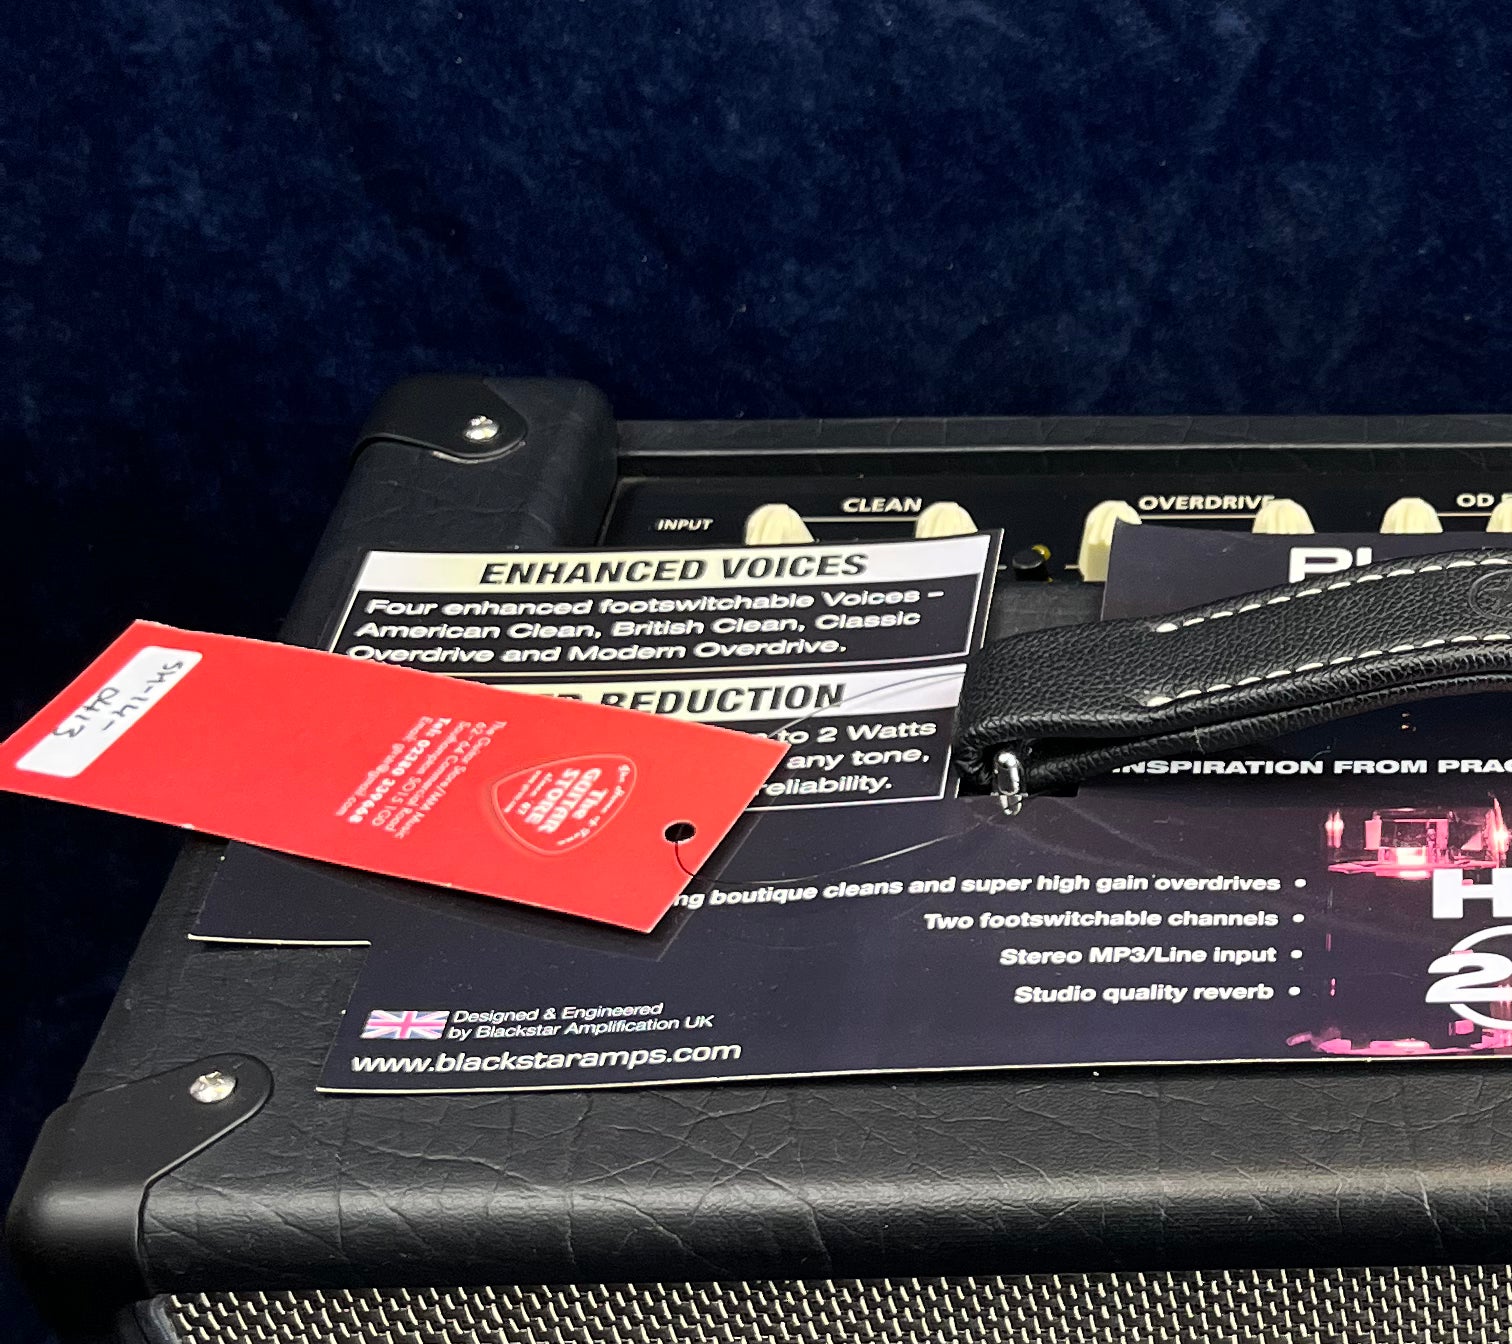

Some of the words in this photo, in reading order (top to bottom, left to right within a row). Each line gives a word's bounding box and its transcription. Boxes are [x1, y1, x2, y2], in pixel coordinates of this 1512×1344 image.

[842, 497, 922, 513] CLEAN
[1456, 493, 1495, 507] OD
[656, 518, 713, 531] INPUT
[480, 559, 706, 584] ENHANCED
[722, 554, 869, 579] VOICES
[365, 599, 438, 615] Four
[441, 599, 594, 616] enhanced
[599, 593, 815, 614] footswitchable
[821, 590, 921, 608] Voices
[354, 622, 500, 639] American
[506, 622, 602, 640] Clean,
[611, 619, 705, 637] British
[711, 615, 805, 635] Clean,
[815, 611, 921, 630] Classic
[346, 645, 494, 663] Overdrive
[502, 646, 561, 663] and
[567, 642, 687, 662] Modern
[693, 639, 847, 658] Overdrive.
[600, 683, 846, 716] REDUCTION
[776, 730, 809, 745] to
[816, 726, 838, 743] 2
[846, 721, 938, 742] Watts
[787, 754, 844, 771] any
[852, 748, 930, 766] tone,
[1112, 759, 1324, 775] NSPIRATION
[1334, 759, 1428, 775] FROM
[523, 767, 583, 826] STORE
[709, 886, 818, 905] boutique
[823, 880, 904, 899] cleans
[907, 877, 956, 894] and
[961, 877, 1033, 895] super
[1036, 874, 1090, 894] high
[1096, 874, 1149, 895] gain
[1154, 875, 1281, 892] overdrives
[924, 912, 975, 930] Two
[979, 910, 1162, 929] footswitchable
[1167, 910, 1280, 927] channels
[1000, 948, 1083, 966] Stereo
[1089, 946, 1208, 964] MP3/Line
[1213, 946, 1278, 966] input
[1014, 985, 1097, 1004] Studio
[1102, 983, 1188, 1004] quality
[1193, 982, 1275, 1000] reverb
[453, 1009, 539, 1027] Designed
[543, 1007, 558, 1021] &
[561, 1003, 664, 1023] Engineered
[447, 1025, 472, 1043] by
[476, 1022, 562, 1040] Blackstar
[563, 1017, 682, 1038] Amplification
[685, 1014, 714, 1030] UK
[352, 1043, 742, 1073] www.blackstaramps.com
